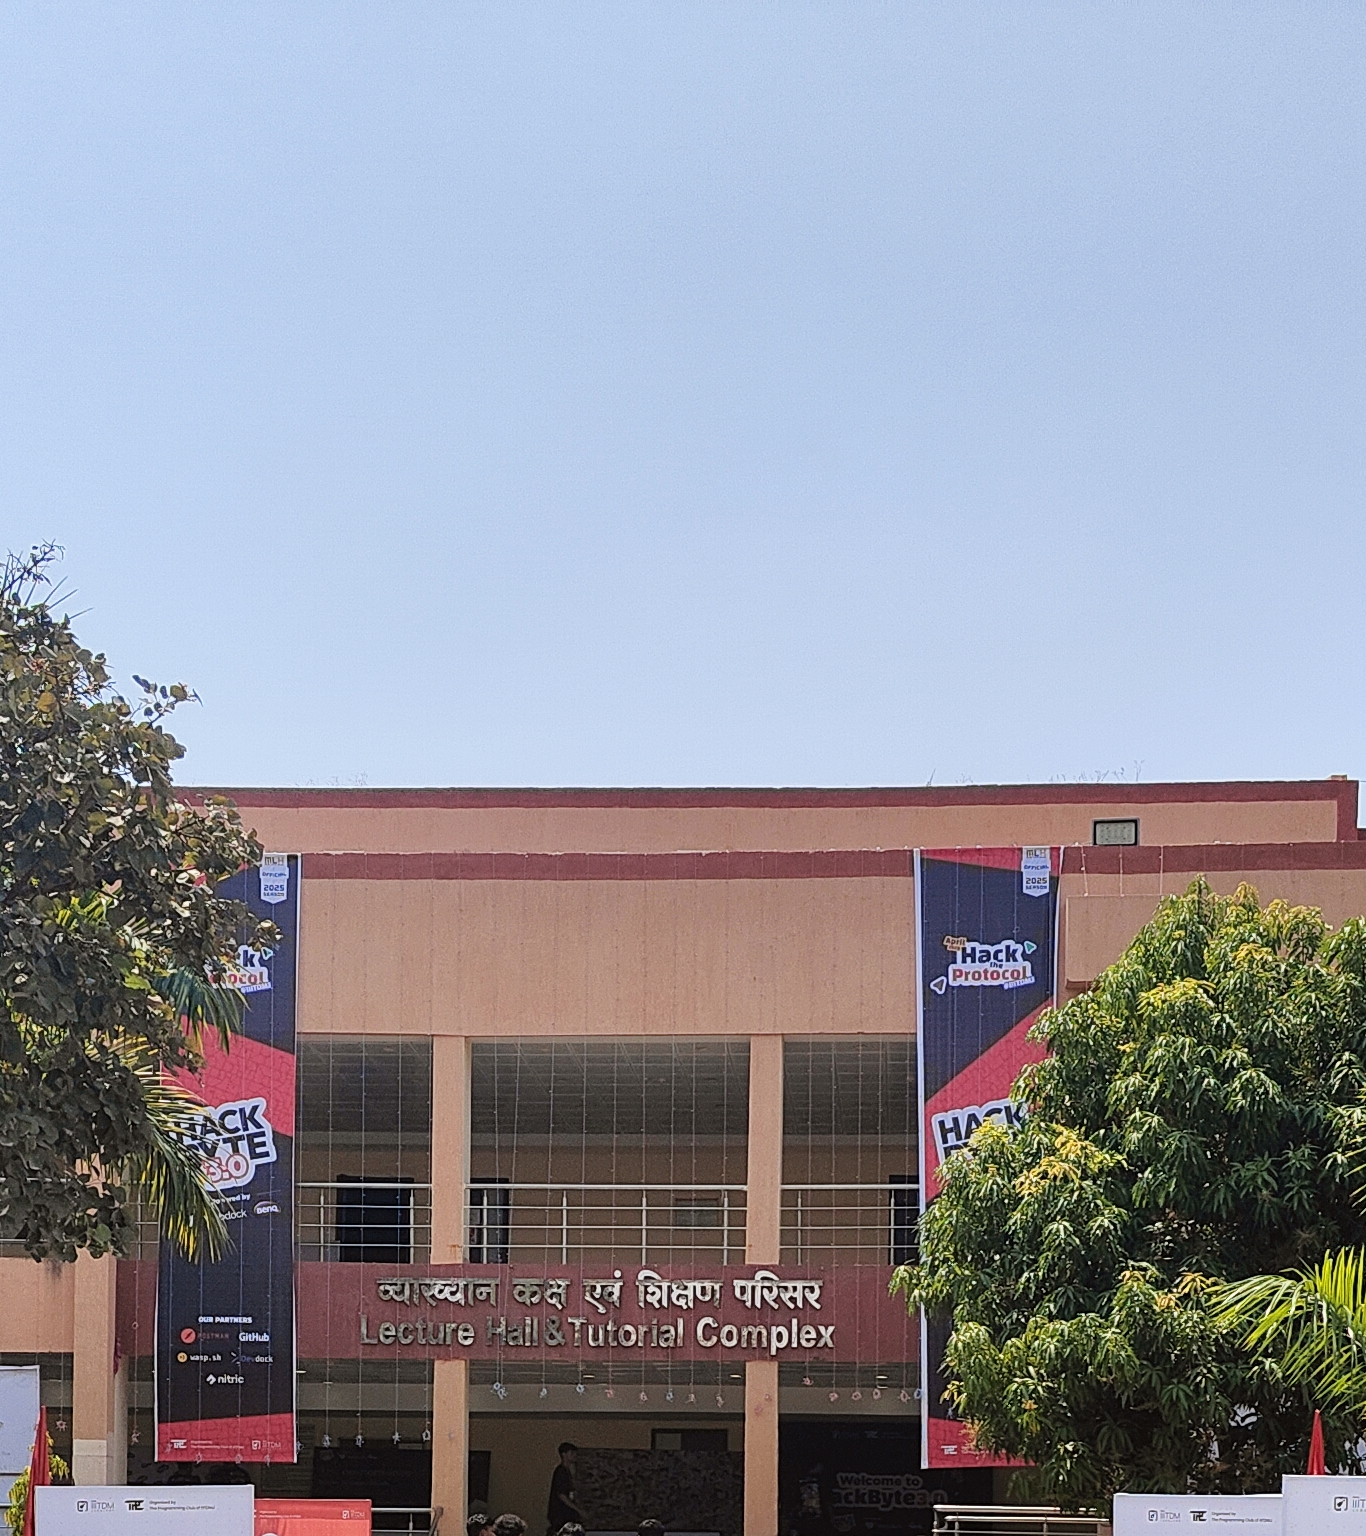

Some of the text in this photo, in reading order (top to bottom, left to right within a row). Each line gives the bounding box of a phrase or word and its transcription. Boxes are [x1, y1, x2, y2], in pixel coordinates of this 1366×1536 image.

[1025, 877, 1047, 885] 2025
[264, 884, 285, 892] 2025
[962, 945, 1019, 963] Hack
[952, 966, 1027, 981] Protocol
[376, 1270, 823, 1314] व्याख्यान कक्ष एवं शिक्षण परिसर
[215, 1316, 253, 1324] PARTNERS
[239, 1332, 270, 1342] GitHub
[360, 1314, 835, 1356] Lecture Hall & Tutorial Complex
[218, 1374, 245, 1384] nitric
[840, 1474, 921, 1486] Welcome to
